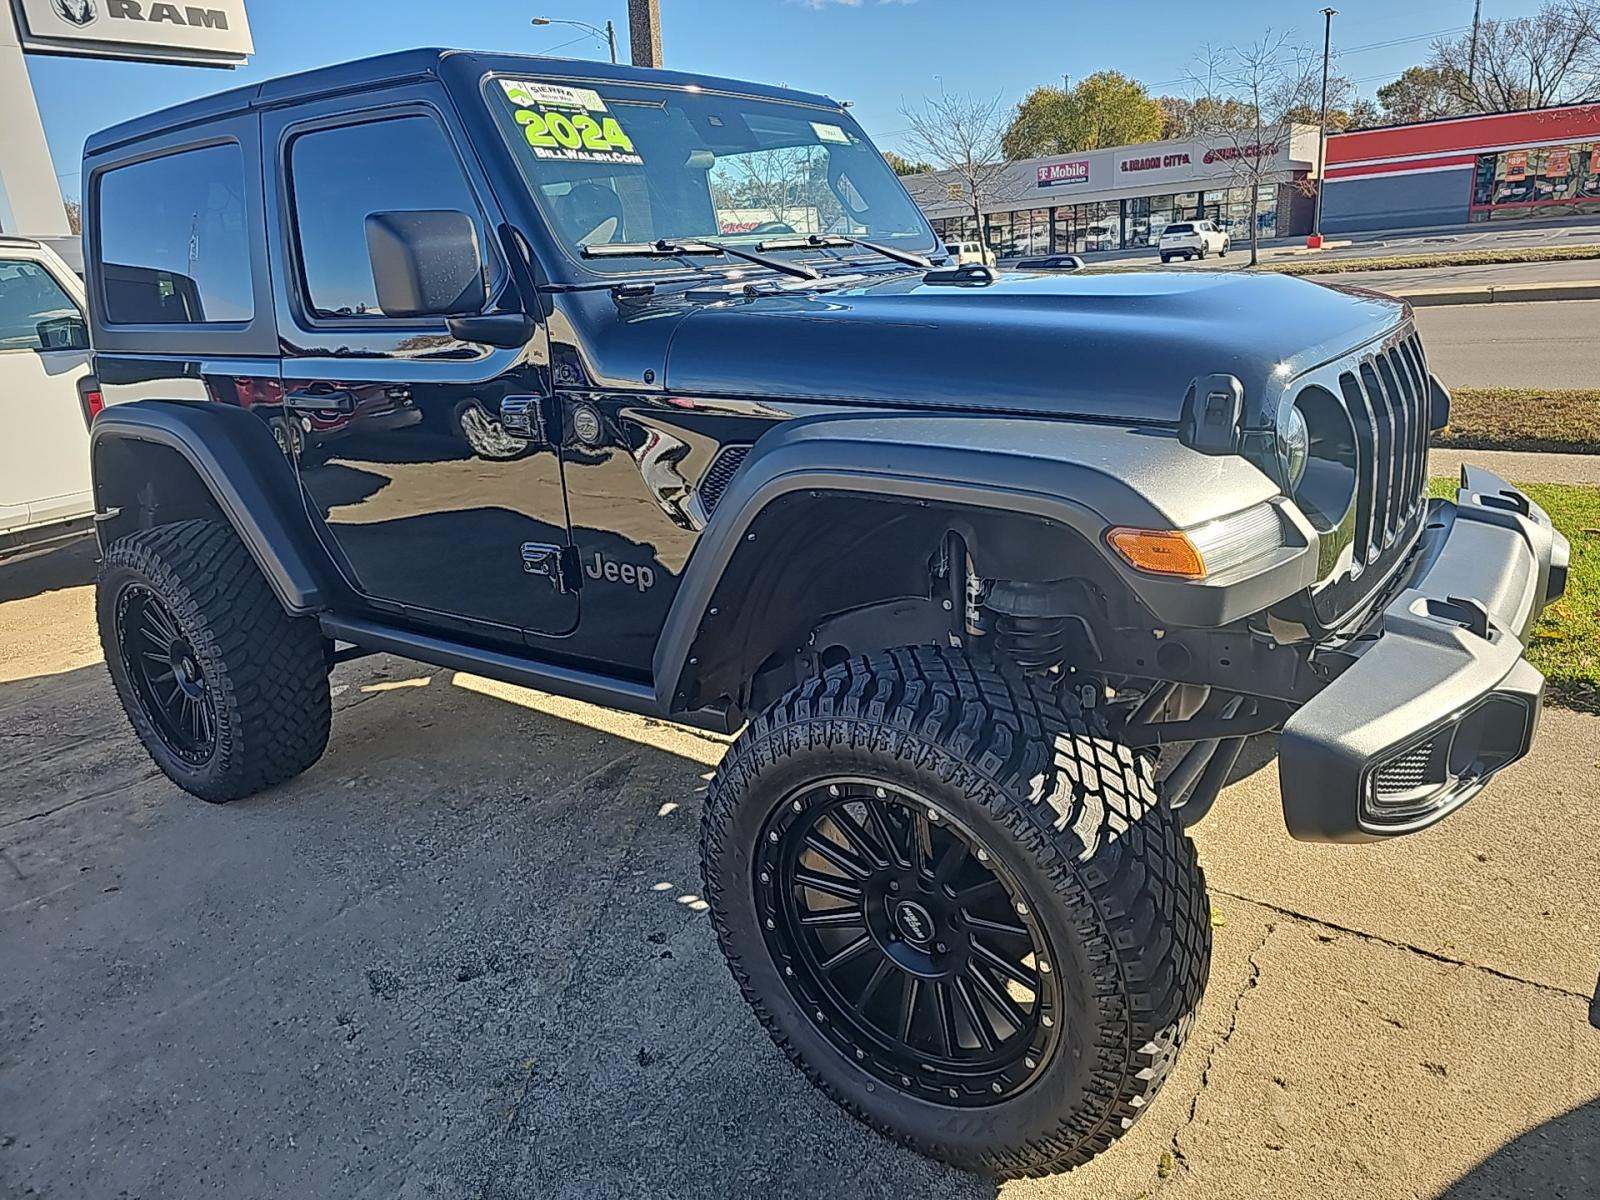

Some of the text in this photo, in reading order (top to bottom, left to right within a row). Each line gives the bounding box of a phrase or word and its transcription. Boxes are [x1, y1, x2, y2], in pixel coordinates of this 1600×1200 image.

[106, 0, 229, 30] RAM
[530, 86, 574, 98] SIERRA
[514, 110, 635, 152] 2024
[1163, 153, 1183, 168] CITY
[585, 552, 655, 592] Jeep
